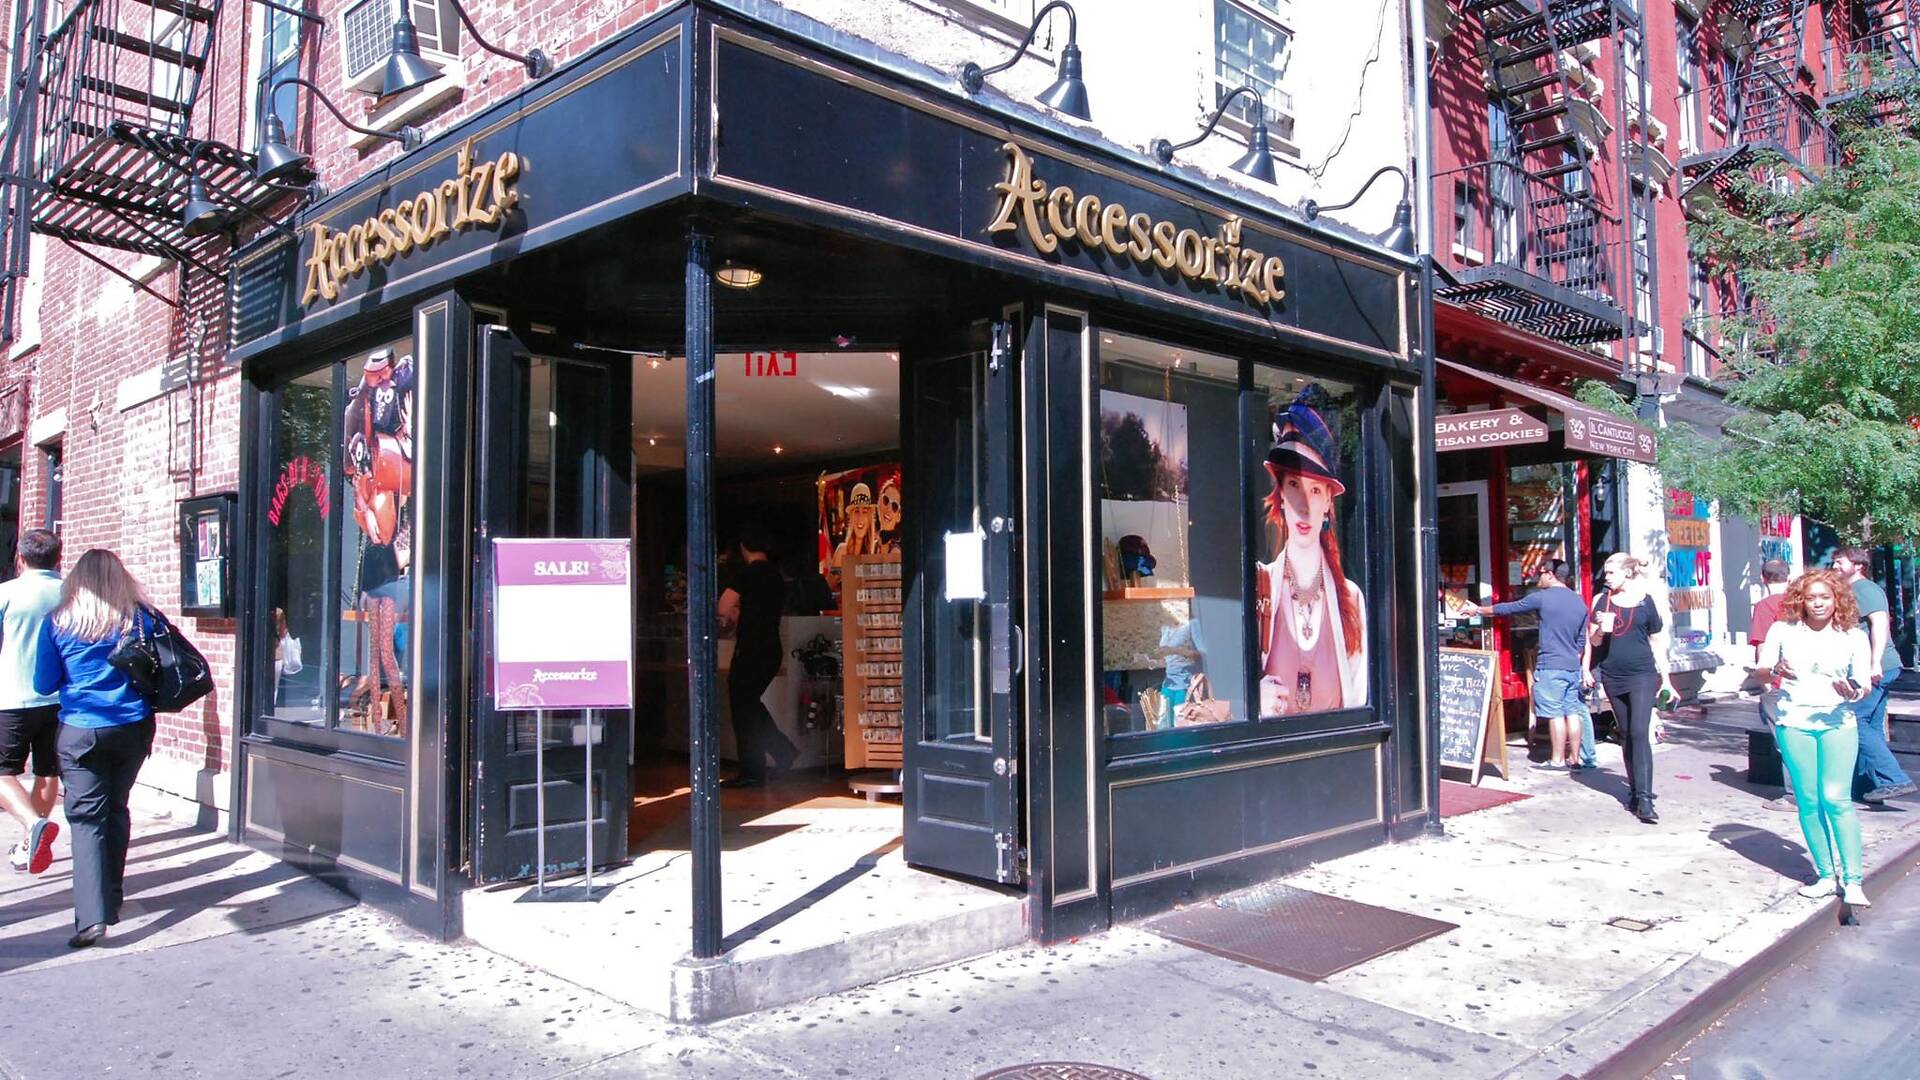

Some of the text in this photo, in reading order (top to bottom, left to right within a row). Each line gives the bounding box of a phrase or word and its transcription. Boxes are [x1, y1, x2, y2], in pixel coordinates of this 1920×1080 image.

[302, 136, 520, 305] Accessorize
[988, 142, 1285, 303] Accessorize
[1436, 414, 1523, 434] BAKERY &
[1598, 423, 1633, 441] CANTUCCIO
[1480, 428, 1544, 442] COOKIES
[1590, 440, 1635, 457] NEW YORK CITY
[534, 561, 590, 576] SALE!
[1696, 551, 1712, 586] OF
[532, 667, 598, 683] Accessorize
